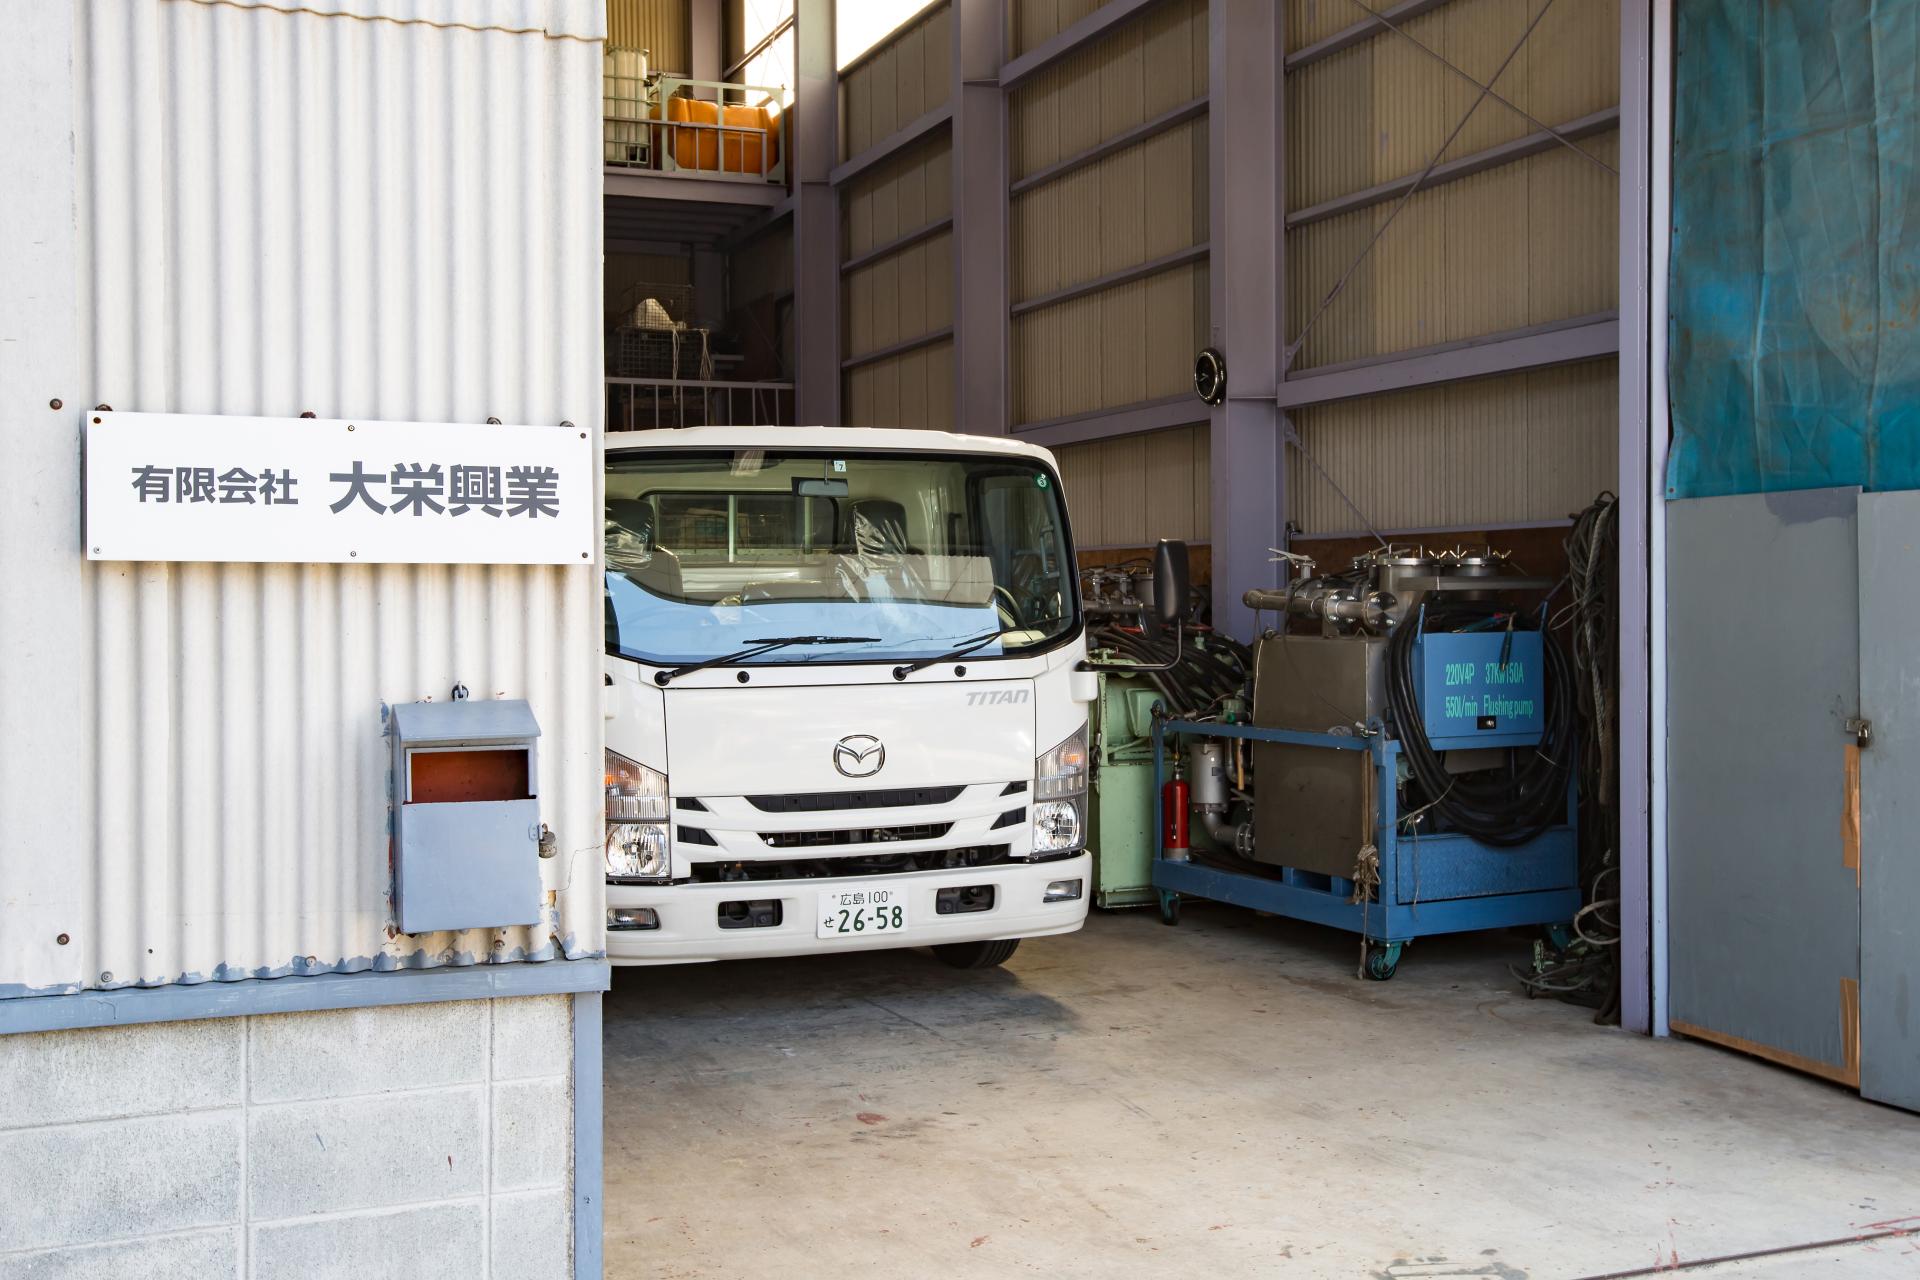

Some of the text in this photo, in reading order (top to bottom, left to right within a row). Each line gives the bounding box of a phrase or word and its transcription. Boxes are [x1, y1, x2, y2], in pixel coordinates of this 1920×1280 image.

[131, 460, 560, 518] 有限会社 大栄興業
[966, 689, 1029, 706] TITAN
[1513, 699, 1534, 719] pump
[838, 905, 903, 933] 26-58
